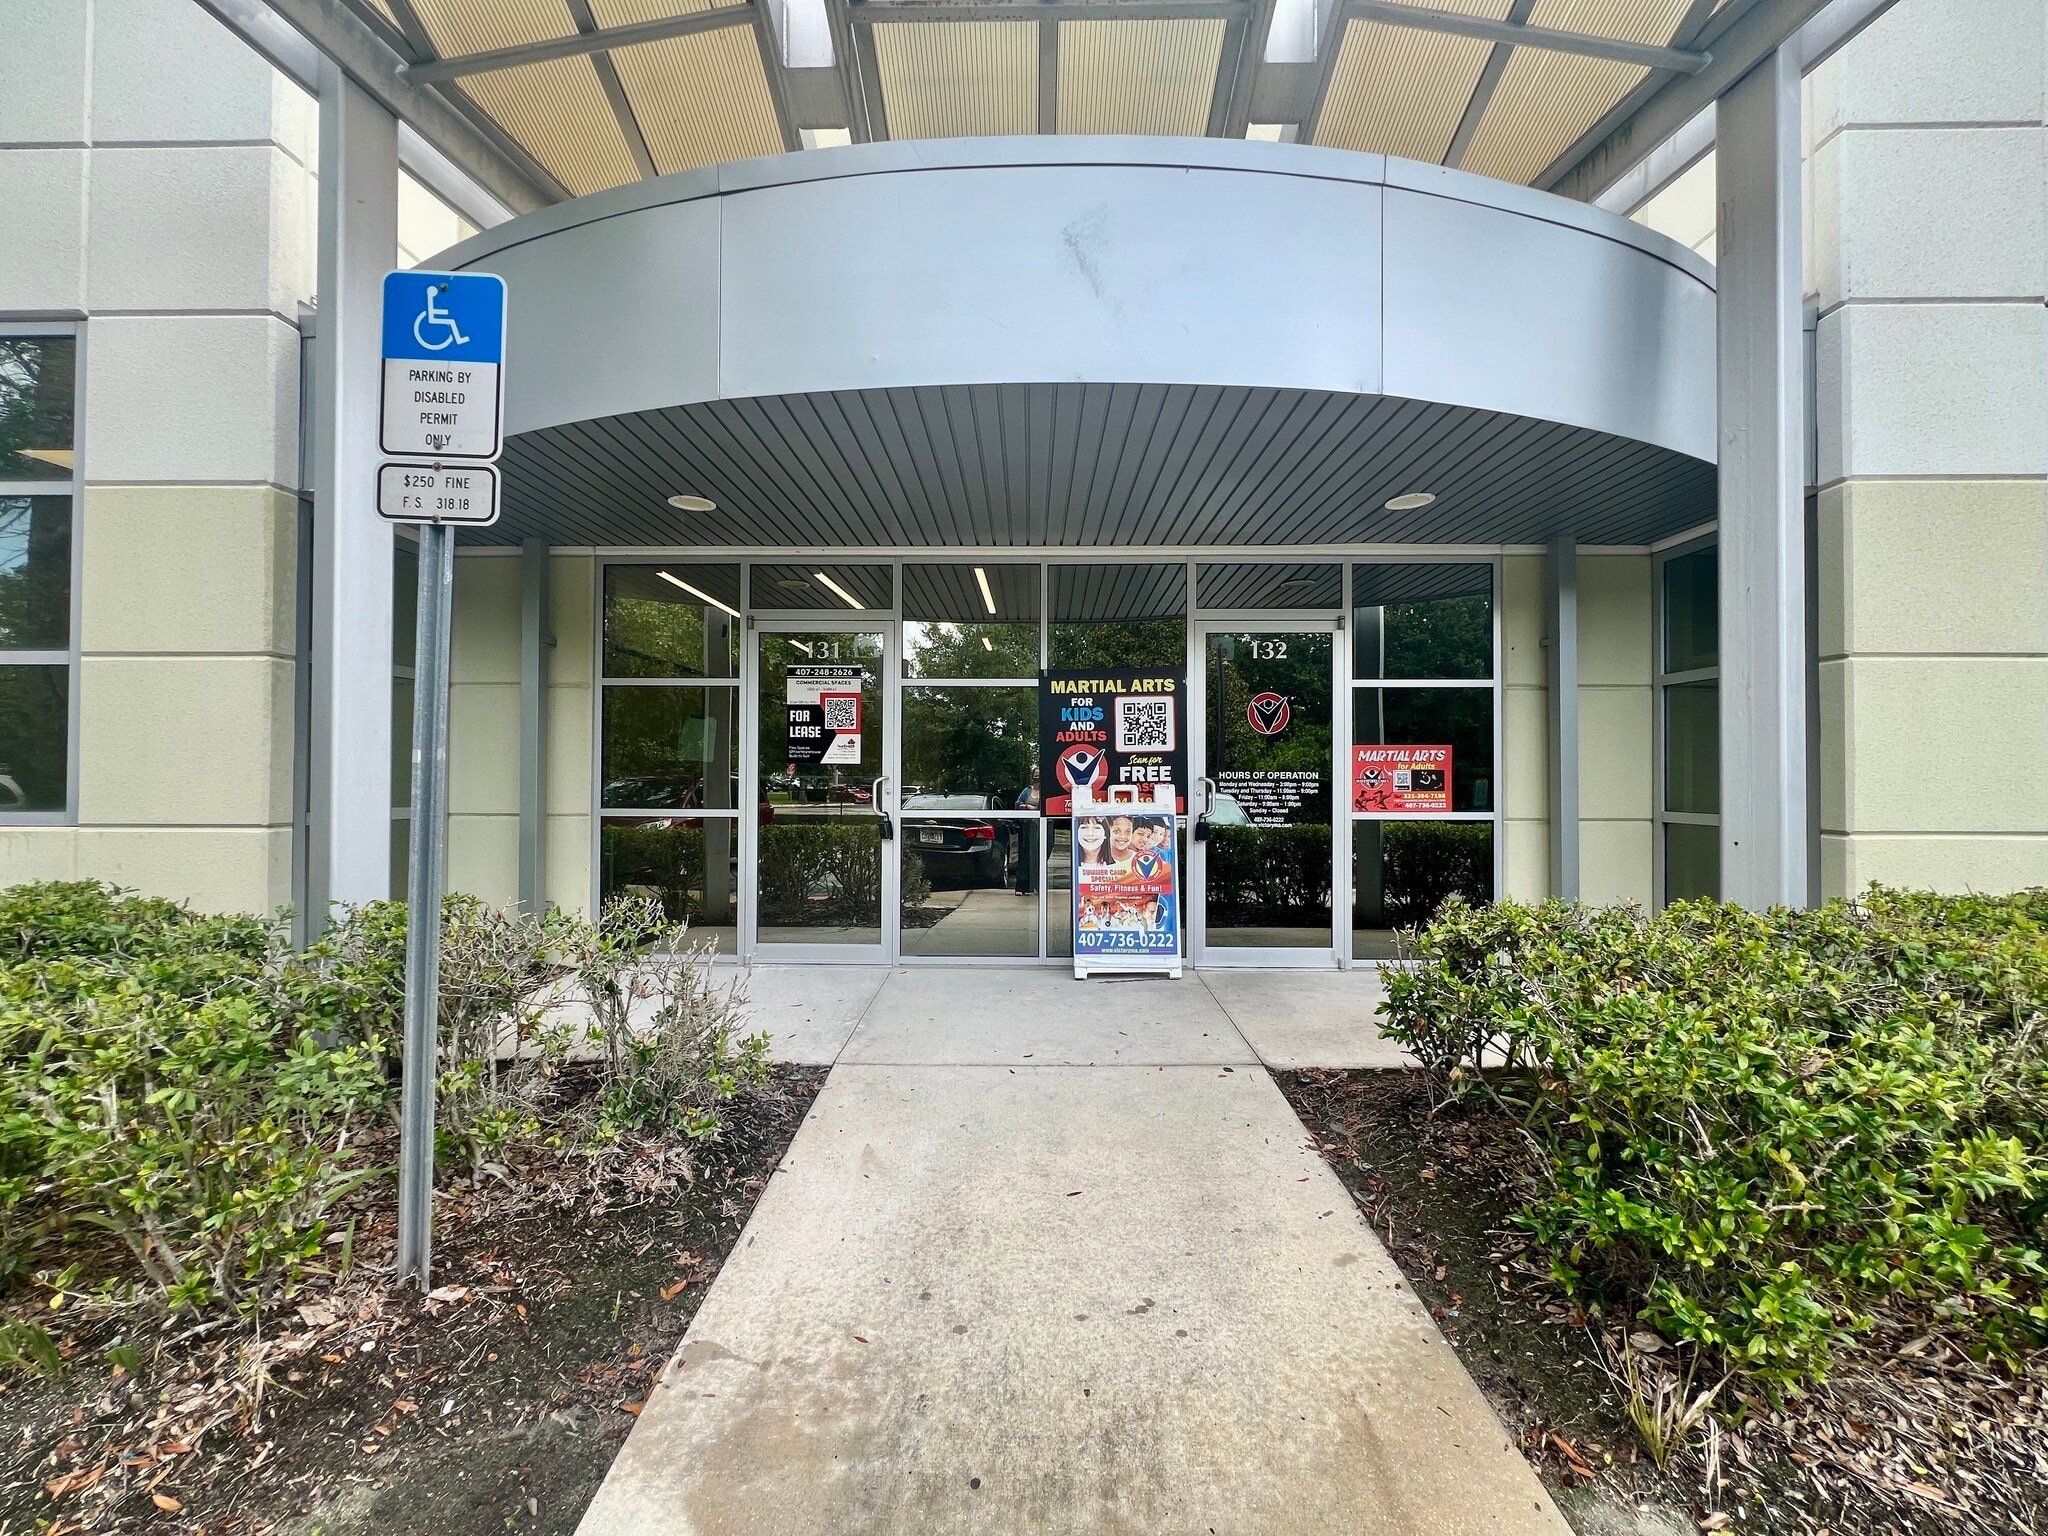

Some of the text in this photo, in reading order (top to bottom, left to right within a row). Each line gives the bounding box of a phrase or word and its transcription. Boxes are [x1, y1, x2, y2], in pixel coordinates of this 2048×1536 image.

[409, 370, 472, 384] PARKING BY
[414, 391, 465, 404] DISABLED
[420, 412, 458, 425] PERMIT
[425, 434, 452, 446] ONLY
[404, 475, 470, 489] $250 FINE
[436, 498, 470, 510] 318.18
[805, 641, 840, 659] 131
[1250, 641, 1287, 660] 132
[795, 668, 853, 676] 407-248-2626
[1050, 679, 1175, 694] MARTIAL ARTS
[1071, 698, 1093, 706] FOR
[790, 710, 810, 722] FOR
[1061, 707, 1104, 721] KIDS
[790, 726, 821, 738] LEASE
[1070, 722, 1095, 731] AND
[1056, 731, 1107, 742] ADULTS
[1128, 754, 1164, 766] Scan for
[1357, 750, 1446, 762] MARTIAL ARTS
[1120, 766, 1172, 782] FREE
[1078, 933, 1174, 947] 407-736-0222
